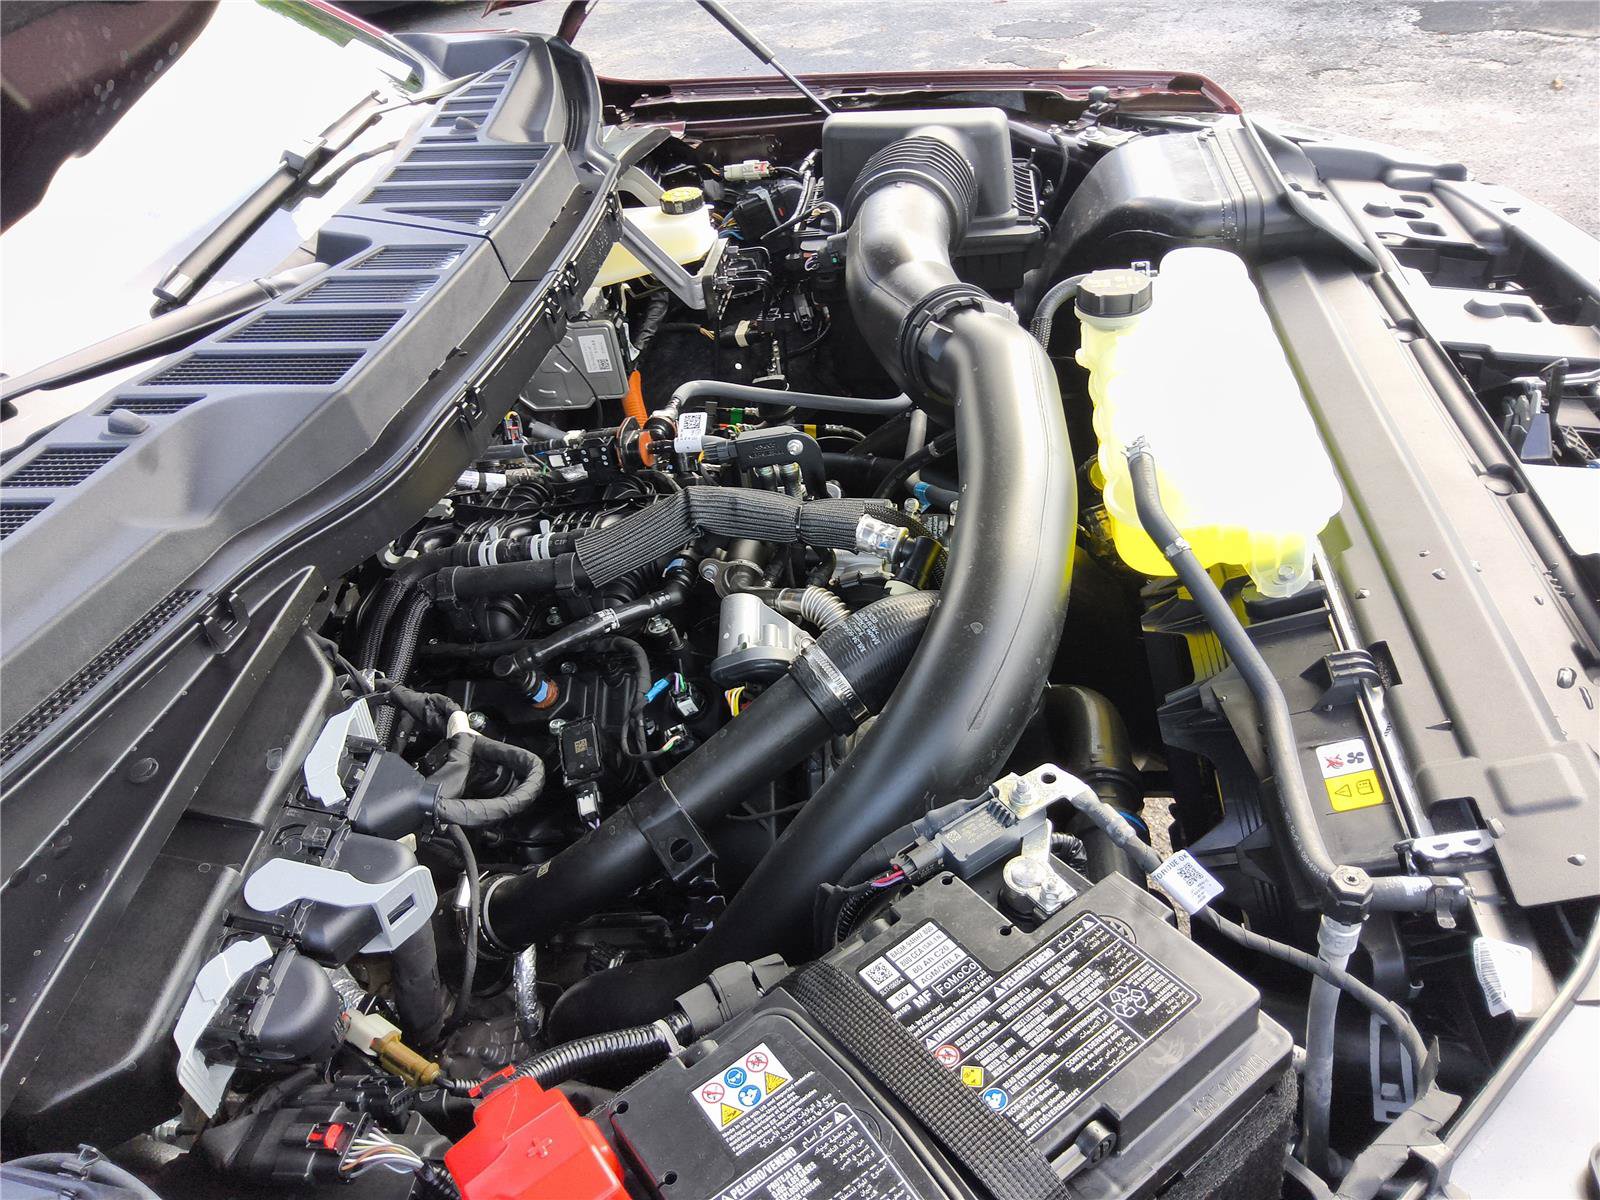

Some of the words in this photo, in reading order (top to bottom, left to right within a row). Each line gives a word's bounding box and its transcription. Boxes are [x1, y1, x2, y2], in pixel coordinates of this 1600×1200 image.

[899, 956, 912, 967] 800
[910, 947, 924, 958] CCA
[912, 964, 922, 973] 80
[921, 955, 934, 965] Ah
[933, 945, 949, 957] C20
[919, 952, 961, 983] AGM/VRLA
[1000, 948, 1055, 989] PELIGRO/VENENO
[935, 961, 977, 992] FoMoCo
[895, 989, 909, 1001] 12V
[912, 990, 933, 1007] MF
[1121, 995, 1133, 1005] Pb
[932, 997, 990, 1041] DANGER/POISON
[963, 1029, 975, 1038] OUT
[1064, 1048, 1089, 1067] CONTRA
[1087, 1024, 1118, 1049] DERRAMES
[1005, 1079, 1051, 1116] NON-SPILLABLE
[1011, 1109, 1027, 1122] Lead
[1025, 1099, 1039, 1110] Acid
[1038, 1083, 1059, 1100] Battery
[1018, 1109, 1042, 1129] Batterie
[1040, 1104, 1049, 1112] au
[1046, 1090, 1066, 1106] plomb
[1024, 1121, 1040, 1135] ANTI
[1037, 1088, 1081, 1123] DÉVERSEMENT
[727, 1146, 799, 1198] PELIGRO/VENENO
[766, 1171, 791, 1190] PROTEJA
[789, 1162, 803, 1174] LOS
[786, 1174, 799, 1185] LOS
[797, 1162, 816, 1177] GASES
[799, 1178, 822, 1195] CAUSAR
